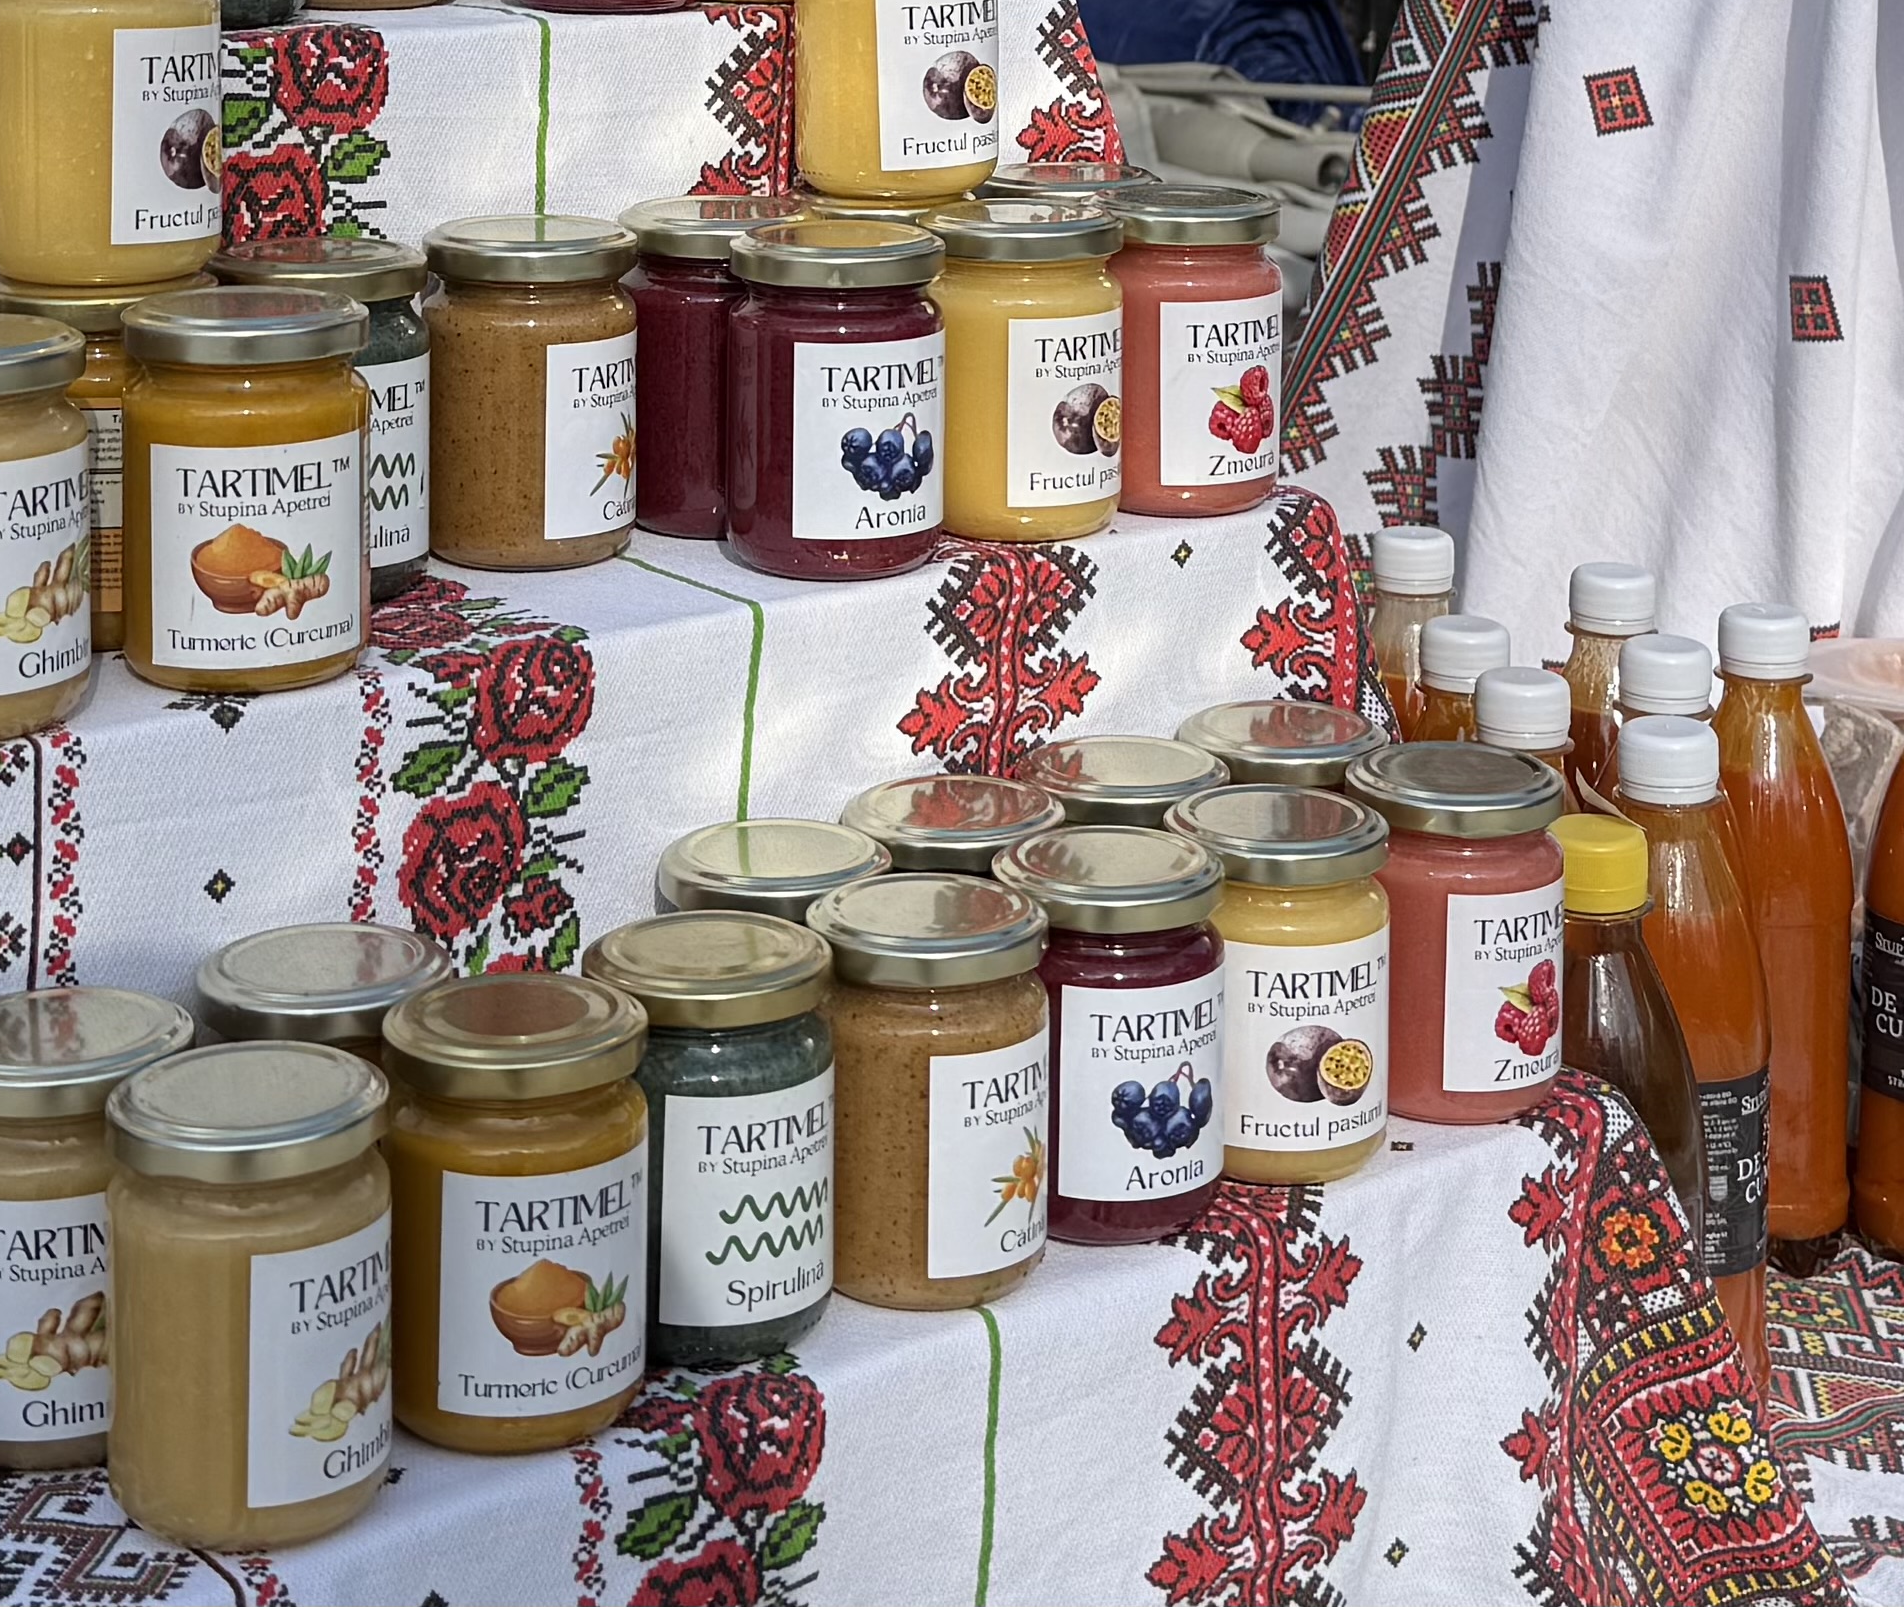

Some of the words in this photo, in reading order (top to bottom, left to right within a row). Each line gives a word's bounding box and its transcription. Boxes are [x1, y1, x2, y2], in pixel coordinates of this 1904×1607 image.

[924, 31, 970, 47] Stupina
[903, 134, 966, 155] Fructul
[135, 205, 204, 229] Fructul
[1207, 348, 1254, 365] Stupina
[1055, 362, 1100, 380] Stupina
[843, 394, 898, 412] Stupina
[1030, 472, 1095, 492] Fructul
[178, 503, 195, 515] BY
[200, 501, 267, 520] Stupina
[272, 490, 331, 516] Apetrei
[855, 503, 926, 530] Aronia
[10, 523, 66, 541] Stupina
[167, 629, 256, 651] Turmeric
[264, 614, 353, 650] (Curcuma)
[1495, 945, 1544, 964] Stupina
[1248, 1002, 1265, 1013] BY
[1269, 999, 1330, 1020] Stupina
[1333, 993, 1375, 1014] Apetrei
[1872, 986, 1896, 1013] DE
[1876, 1014, 1903, 1037] CU
[1092, 1047, 1109, 1059] BY
[1114, 1042, 1175, 1063] Stupina
[985, 1100, 1033, 1126] Stupina
[1241, 1114, 1320, 1138] Fructul
[699, 1161, 719, 1173] BY
[723, 1154, 787, 1176] Stupina
[1125, 1159, 1203, 1191] Aronia
[477, 1239, 495, 1251] BY
[502, 1231, 573, 1256] Stupina
[576, 1215, 630, 1246] Apetrei
[9, 1264, 85, 1284] Stupina
[316, 1298, 370, 1332] Stupina
[458, 1373, 558, 1398] Turmeric
[22, 1400, 106, 1428] Ghim
